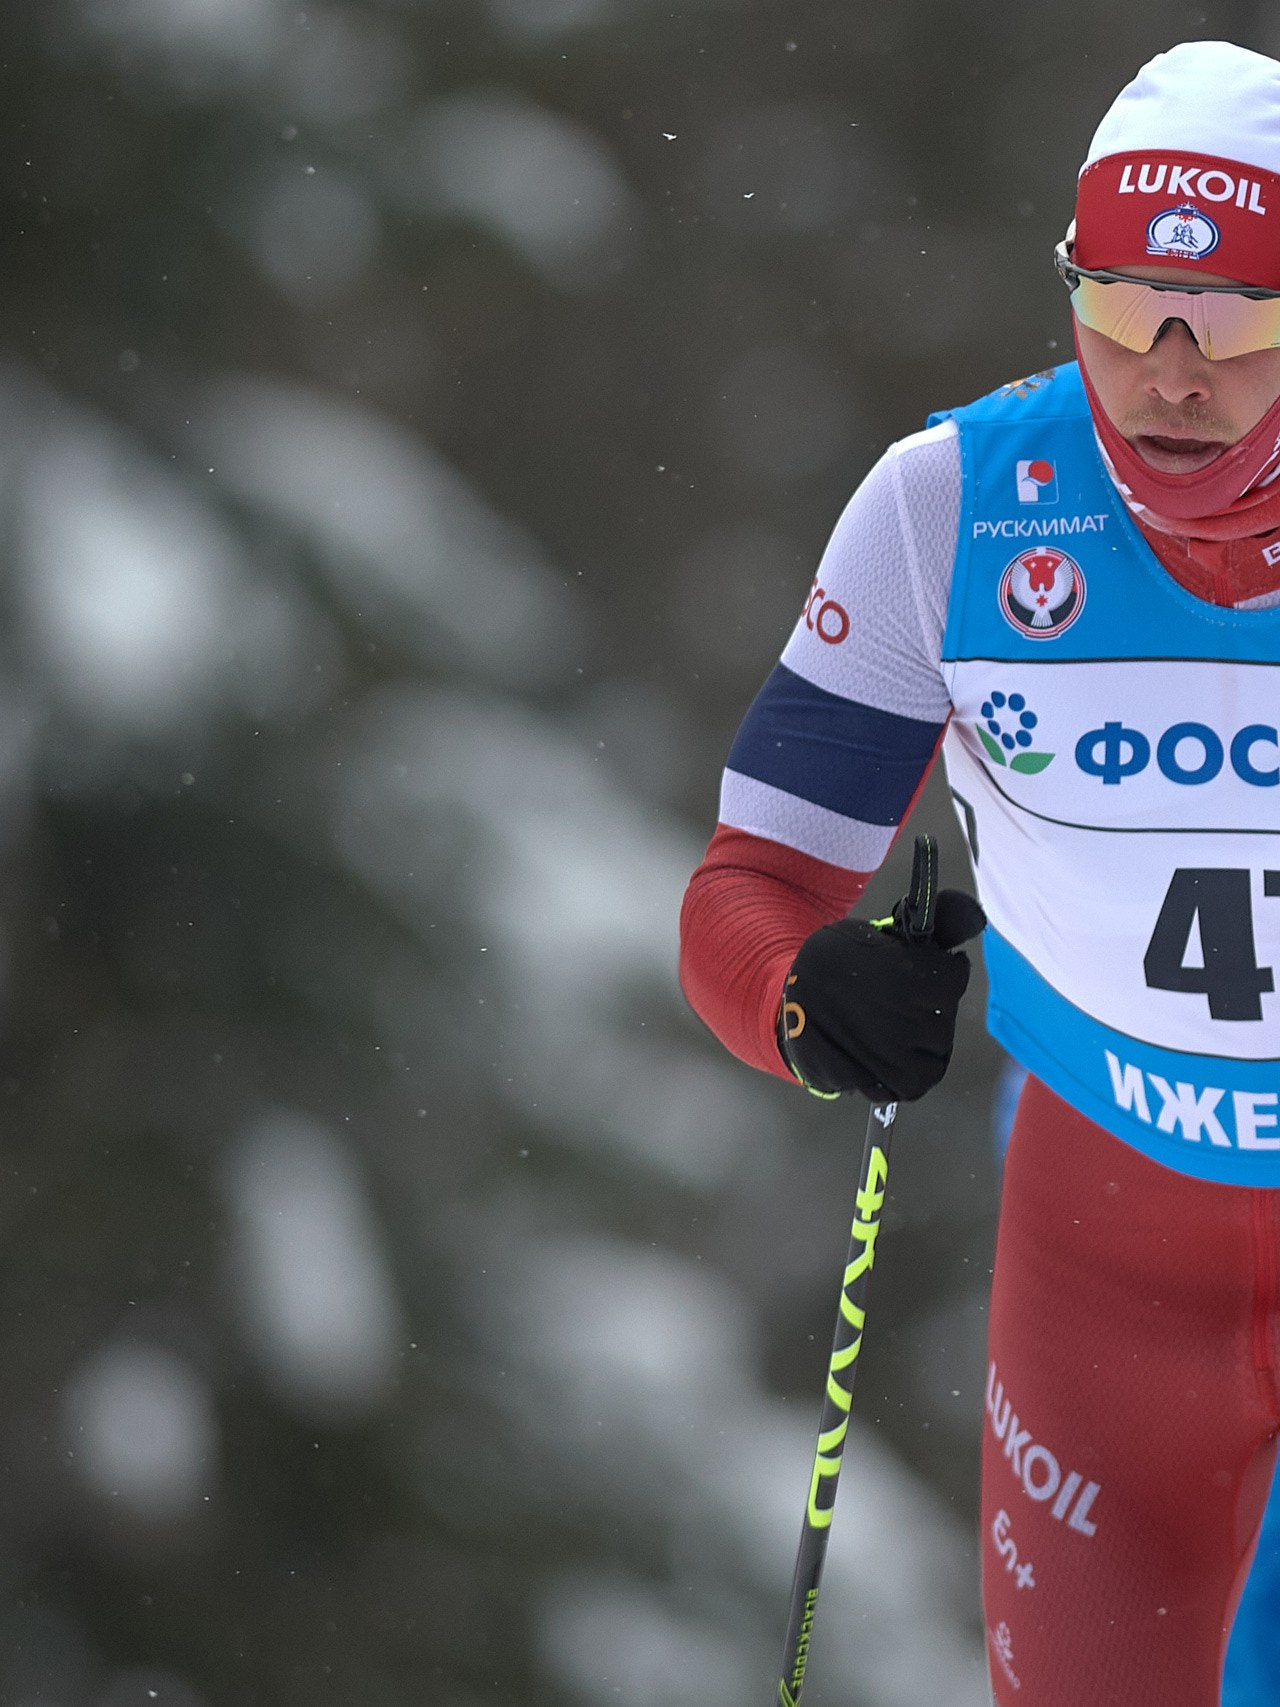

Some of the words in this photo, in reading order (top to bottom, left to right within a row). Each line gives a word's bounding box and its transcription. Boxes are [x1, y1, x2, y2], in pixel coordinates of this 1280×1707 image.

[1118, 164, 1266, 215] LUKOIL
[973, 514, 1109, 539] РУСКЛИМАТ
[802, 576, 850, 645] CO
[986, 1359, 1101, 1538] LUKOIL
[792, 1587, 819, 1689] BLACKCODE
